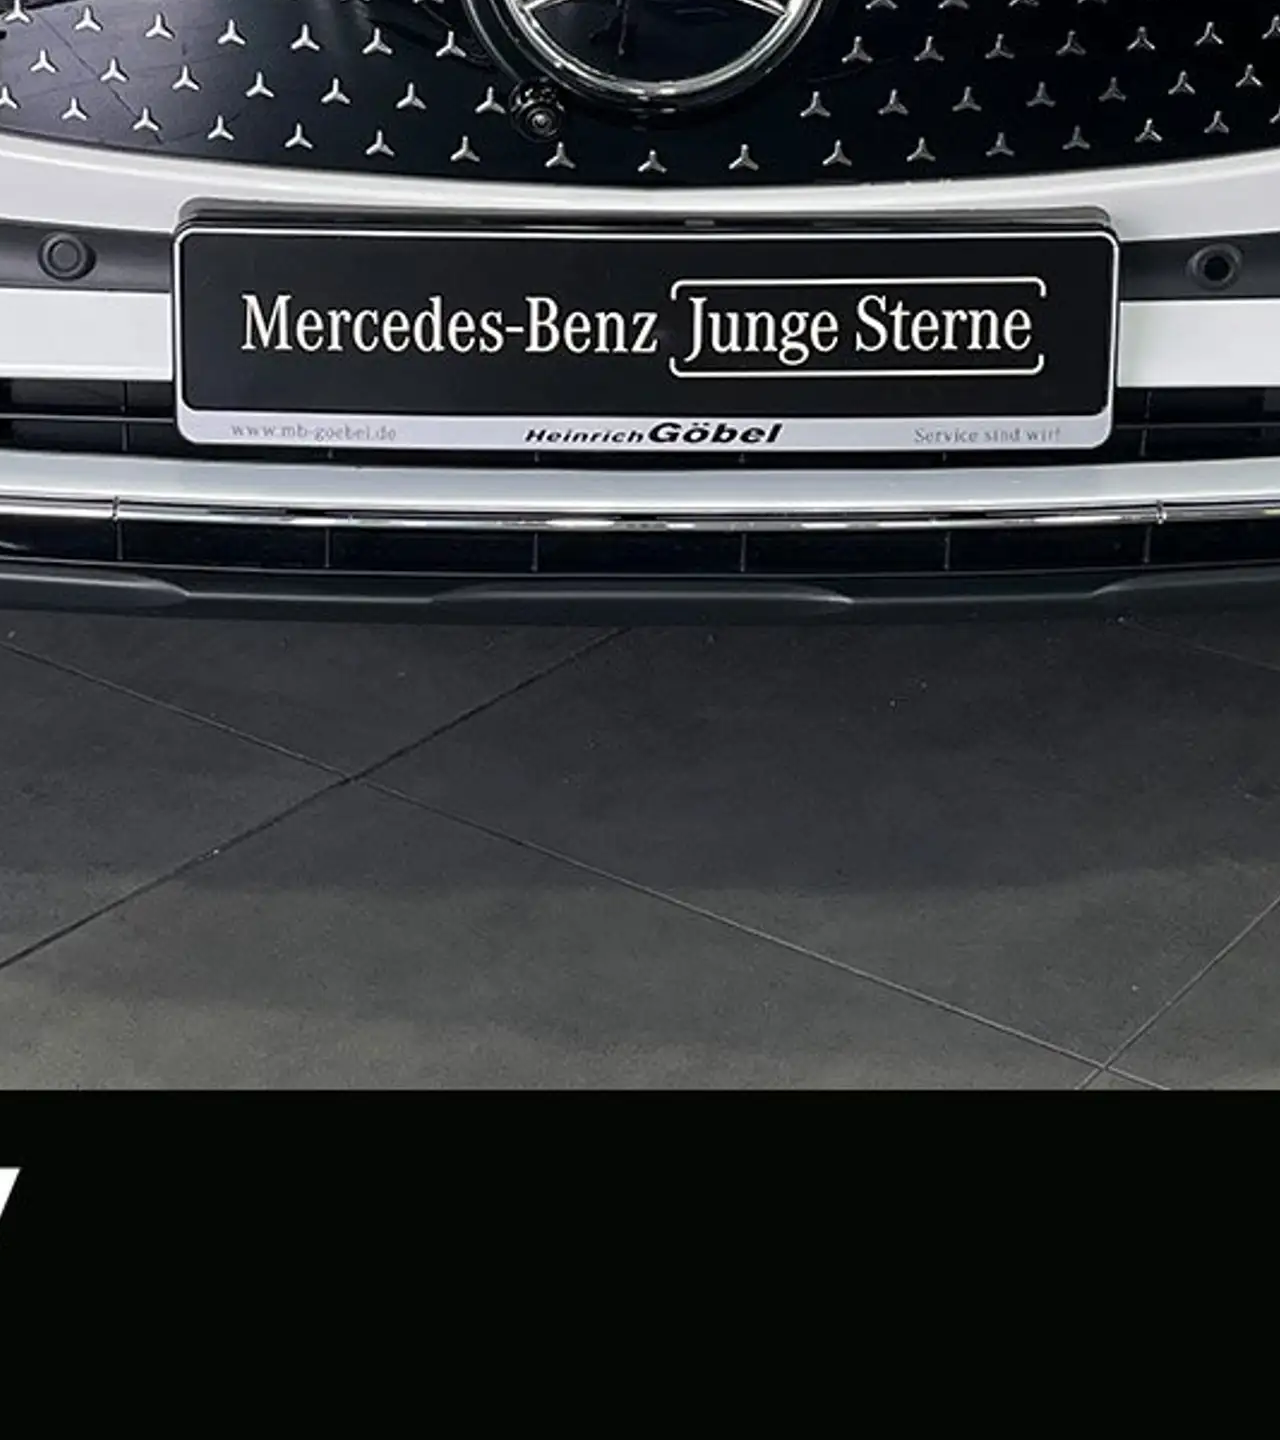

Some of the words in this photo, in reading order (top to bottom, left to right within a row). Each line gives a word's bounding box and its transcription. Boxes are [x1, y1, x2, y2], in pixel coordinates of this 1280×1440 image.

[240, 293, 659, 354] Mercedes-Benz
[683, 295, 839, 366] Junge
[854, 293, 1033, 353] Sterne
[524, 427, 644, 444] Heinrich
[647, 421, 784, 444] Göbel
[914, 426, 979, 444] Service
[983, 426, 1021, 443] sind
